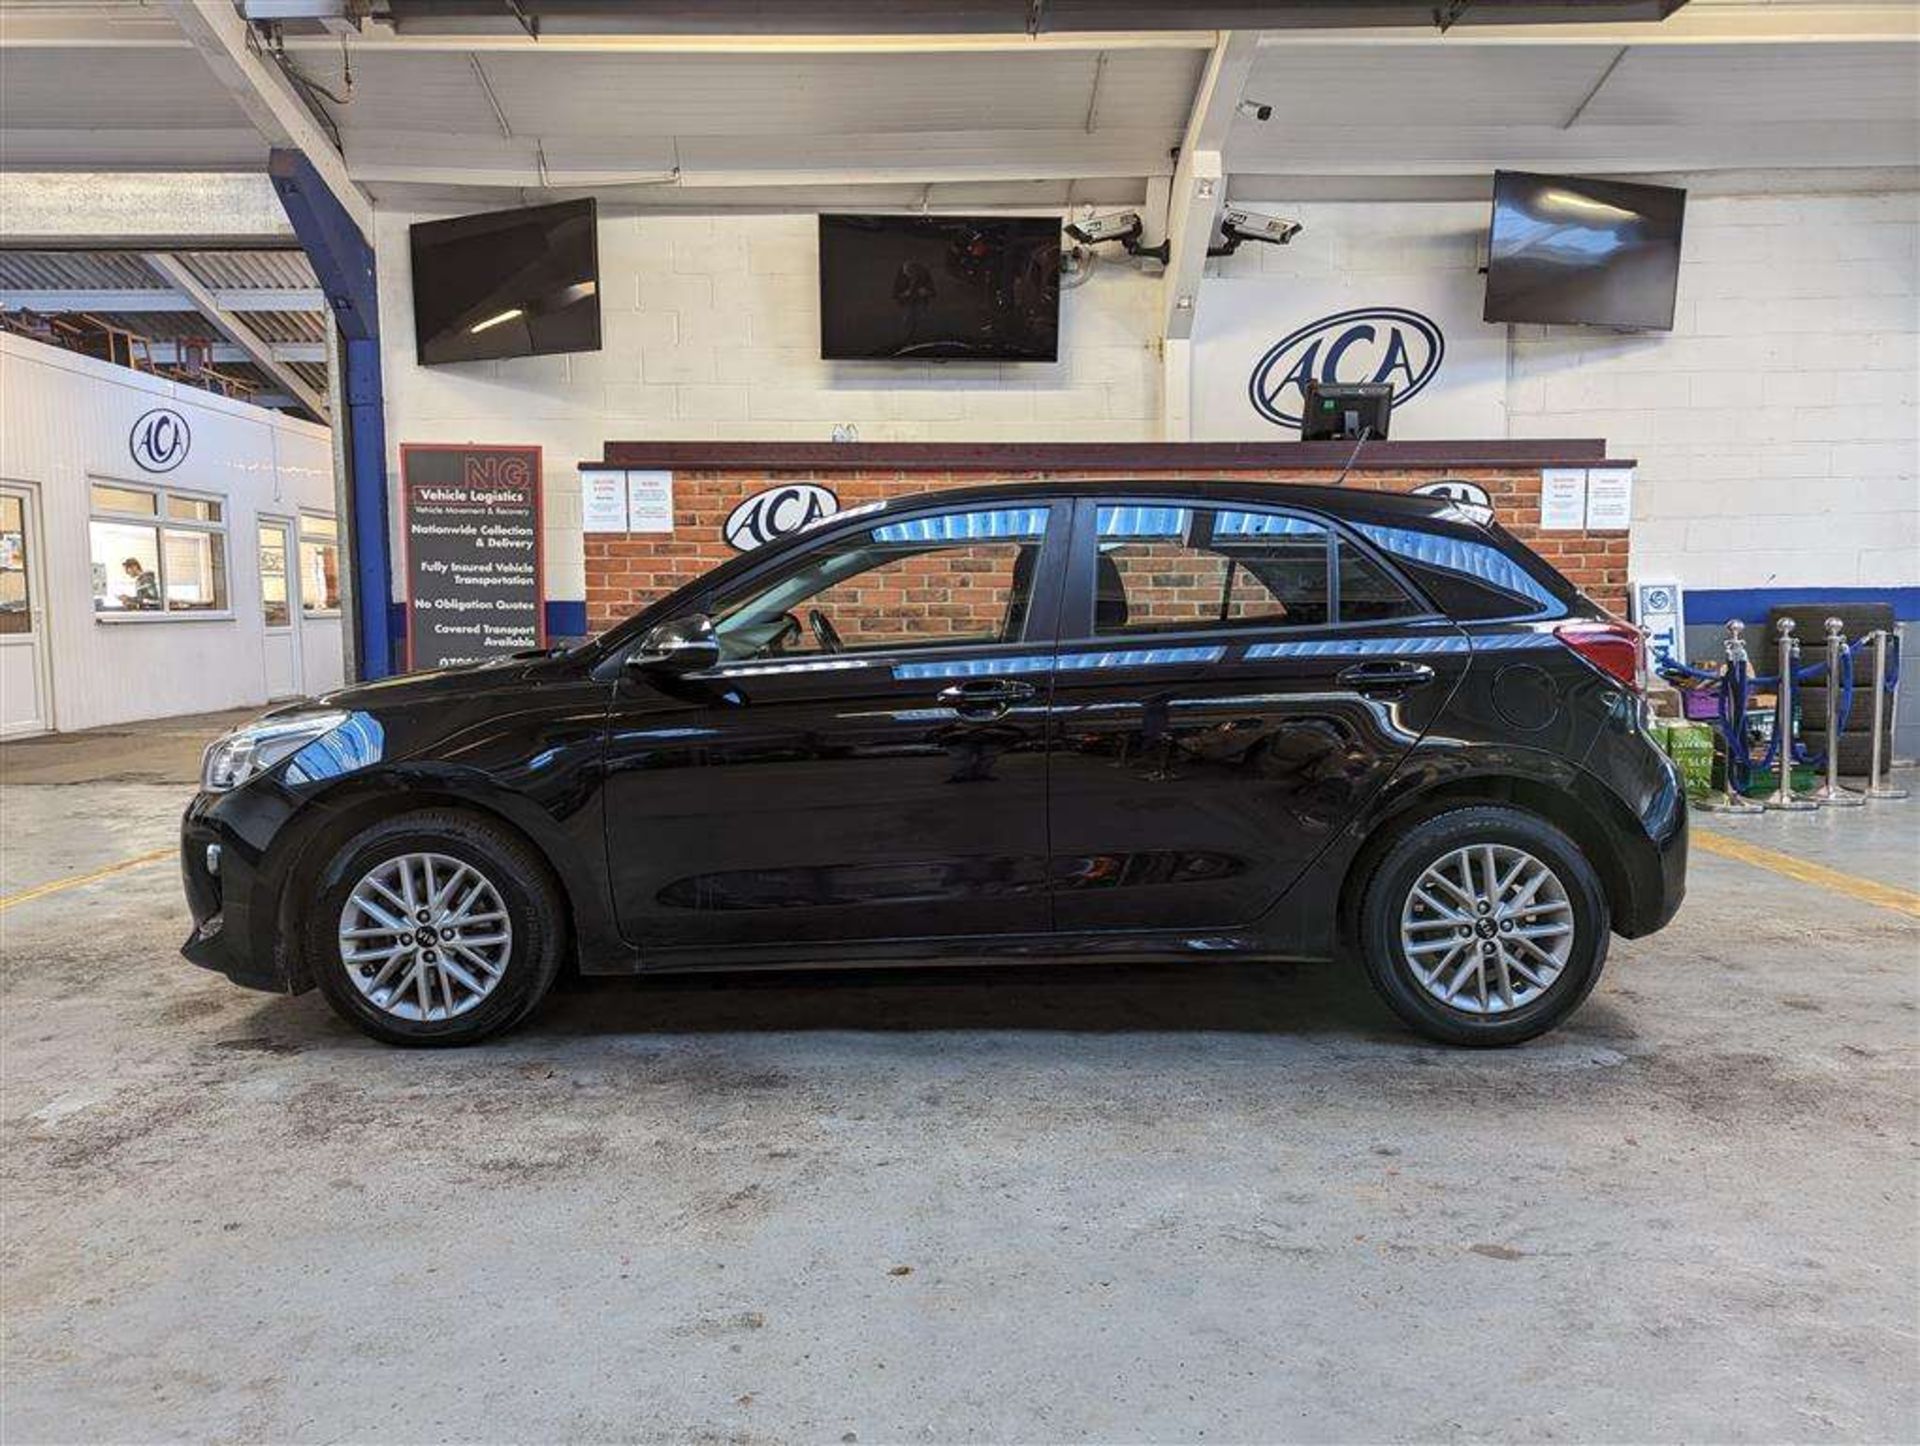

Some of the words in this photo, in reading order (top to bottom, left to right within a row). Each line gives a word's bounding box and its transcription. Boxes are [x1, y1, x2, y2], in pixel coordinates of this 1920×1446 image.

[1267, 324, 1416, 405] ACA
[136, 415, 184, 464] ACA
[464, 456, 530, 489] NG
[420, 488, 466, 501] Vehicle
[470, 489, 524, 505] Logistics
[730, 489, 824, 545] ACA
[411, 524, 478, 535] Nationwide
[480, 524, 534, 536] Collection
[475, 538, 484, 548] &
[487, 538, 534, 551] Delivery
[421, 561, 449, 575] Fully
[451, 562, 493, 572] Insured
[495, 562, 535, 573] Vehicle
[454, 574, 535, 587] Transportation
[415, 598, 432, 609] No
[434, 598, 494, 612] Obligation
[496, 600, 535, 610] Quotes
[434, 624, 481, 634] Covered
[483, 624, 535, 636] Transport
[484, 636, 535, 647] Available
